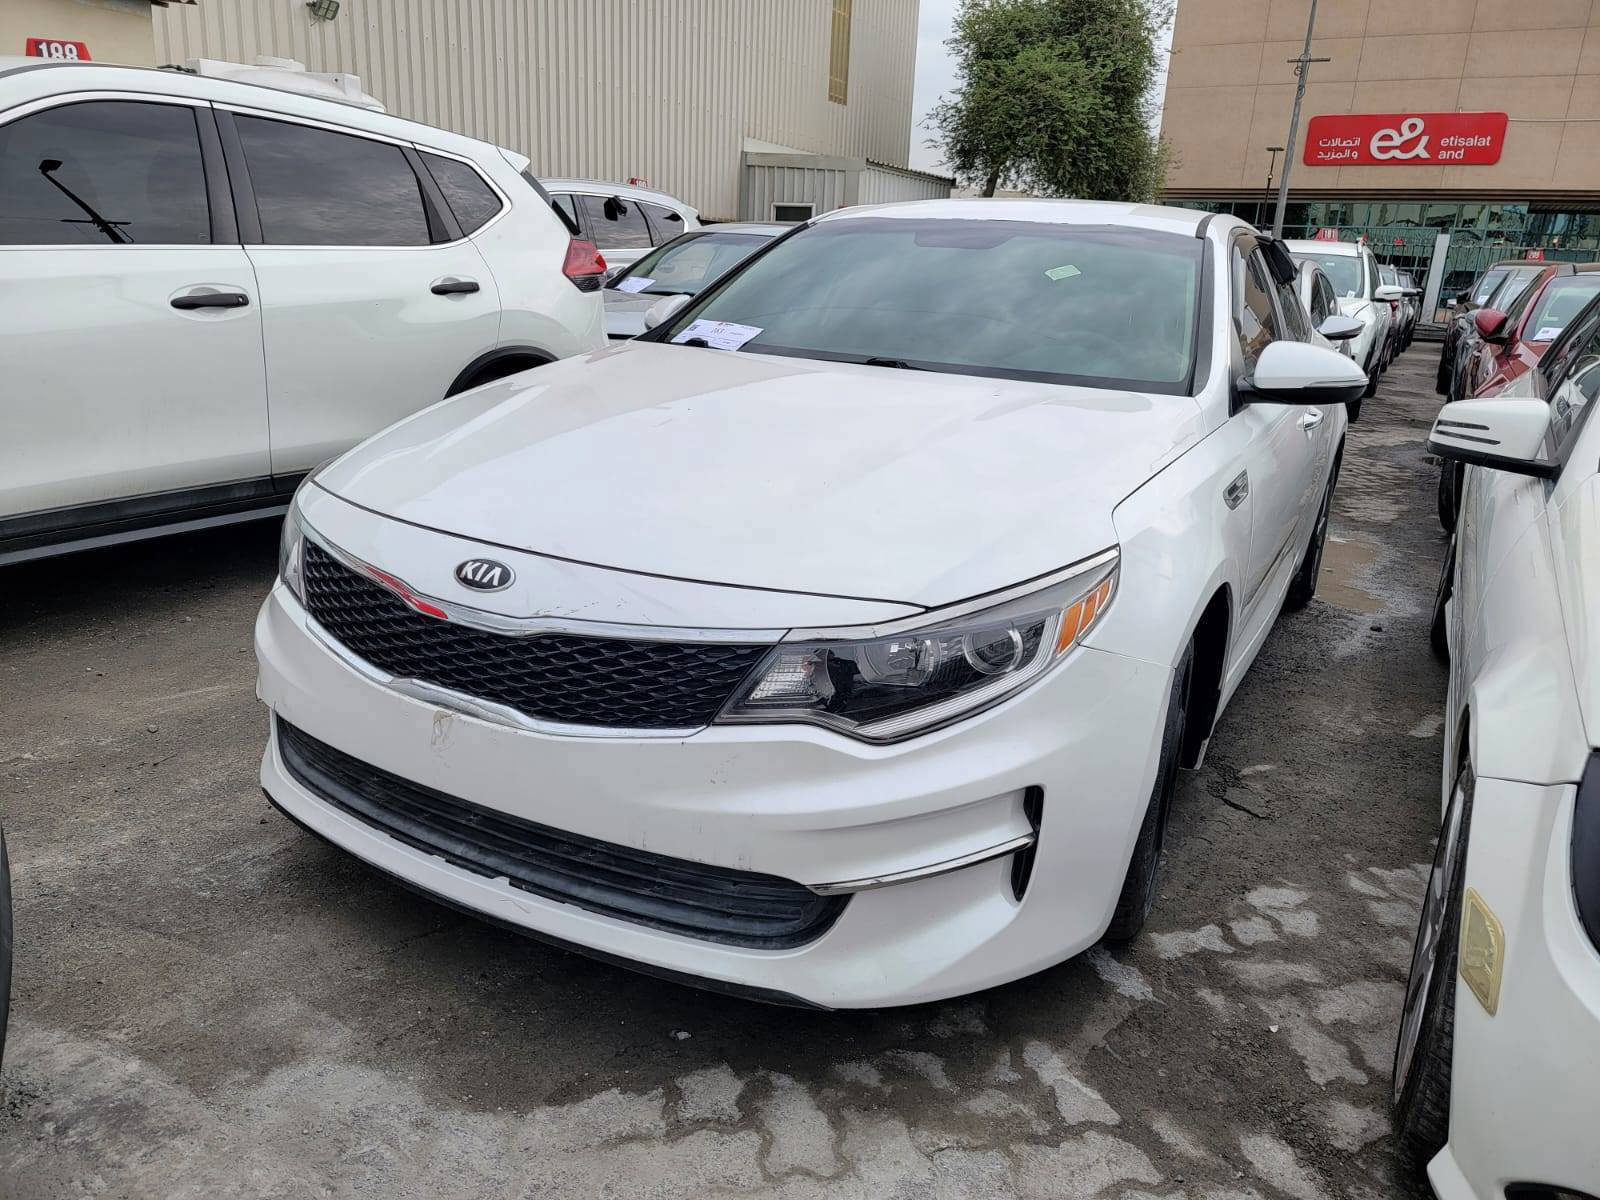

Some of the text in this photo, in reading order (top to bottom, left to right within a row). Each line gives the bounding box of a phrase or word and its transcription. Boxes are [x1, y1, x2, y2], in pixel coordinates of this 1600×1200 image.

[38, 41, 79, 61] 188
[1319, 137, 1361, 147] اتصالات
[1369, 117, 1431, 160] e&
[1440, 135, 1491, 147] etisalat
[1438, 148, 1465, 160] and
[459, 561, 503, 587] KIA
